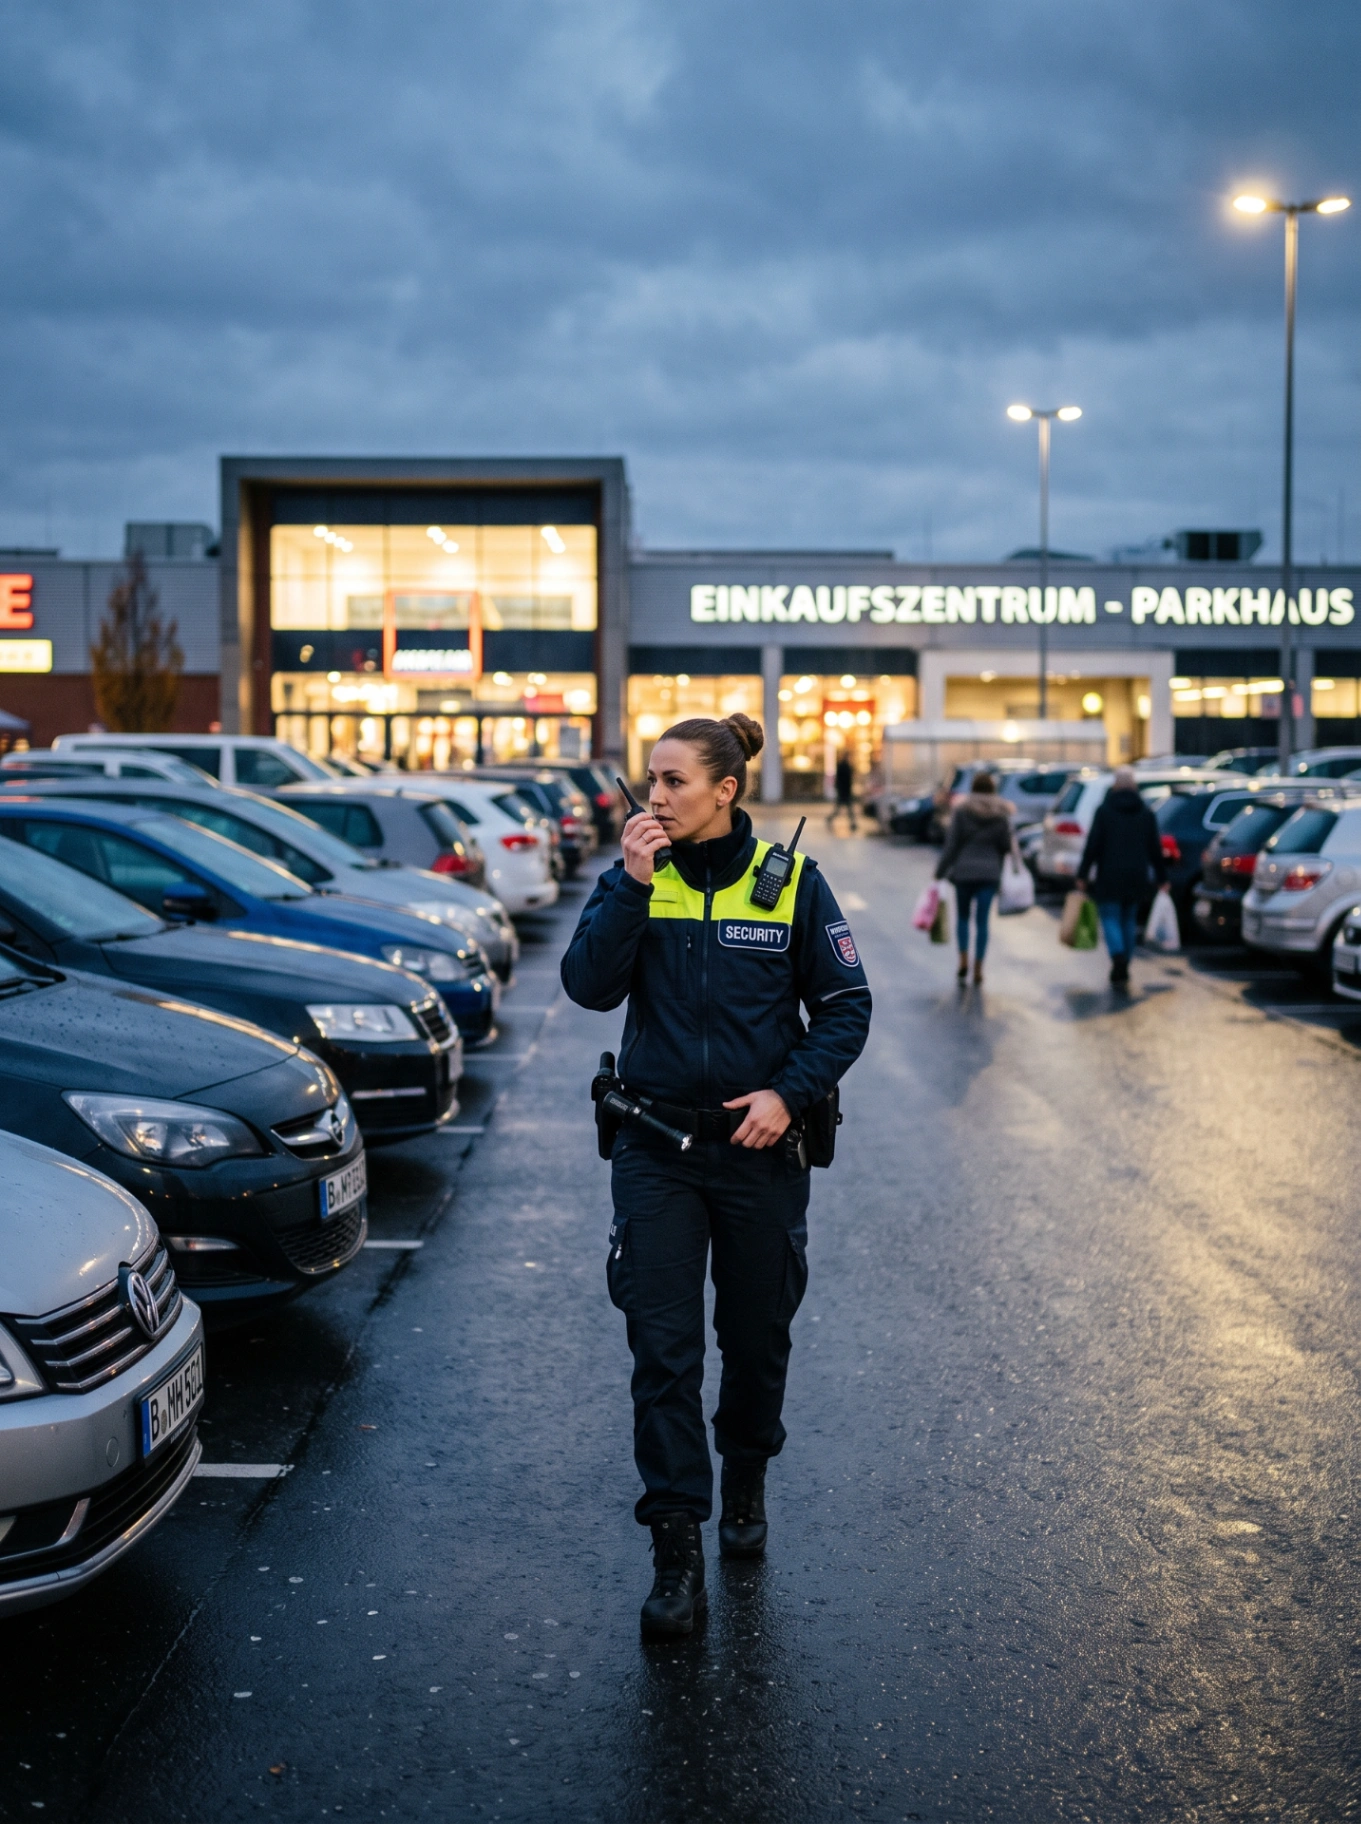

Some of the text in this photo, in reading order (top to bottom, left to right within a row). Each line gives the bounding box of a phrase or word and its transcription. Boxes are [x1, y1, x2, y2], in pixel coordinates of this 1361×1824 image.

[690, 584, 1355, 627] EINKAUFSZENTRUM - PARKHAUS
[725, 925, 784, 944] SECURITY
[327, 1180, 336, 1209] B
[150, 1398, 160, 1442] B
[167, 1373, 184, 1429] MH
